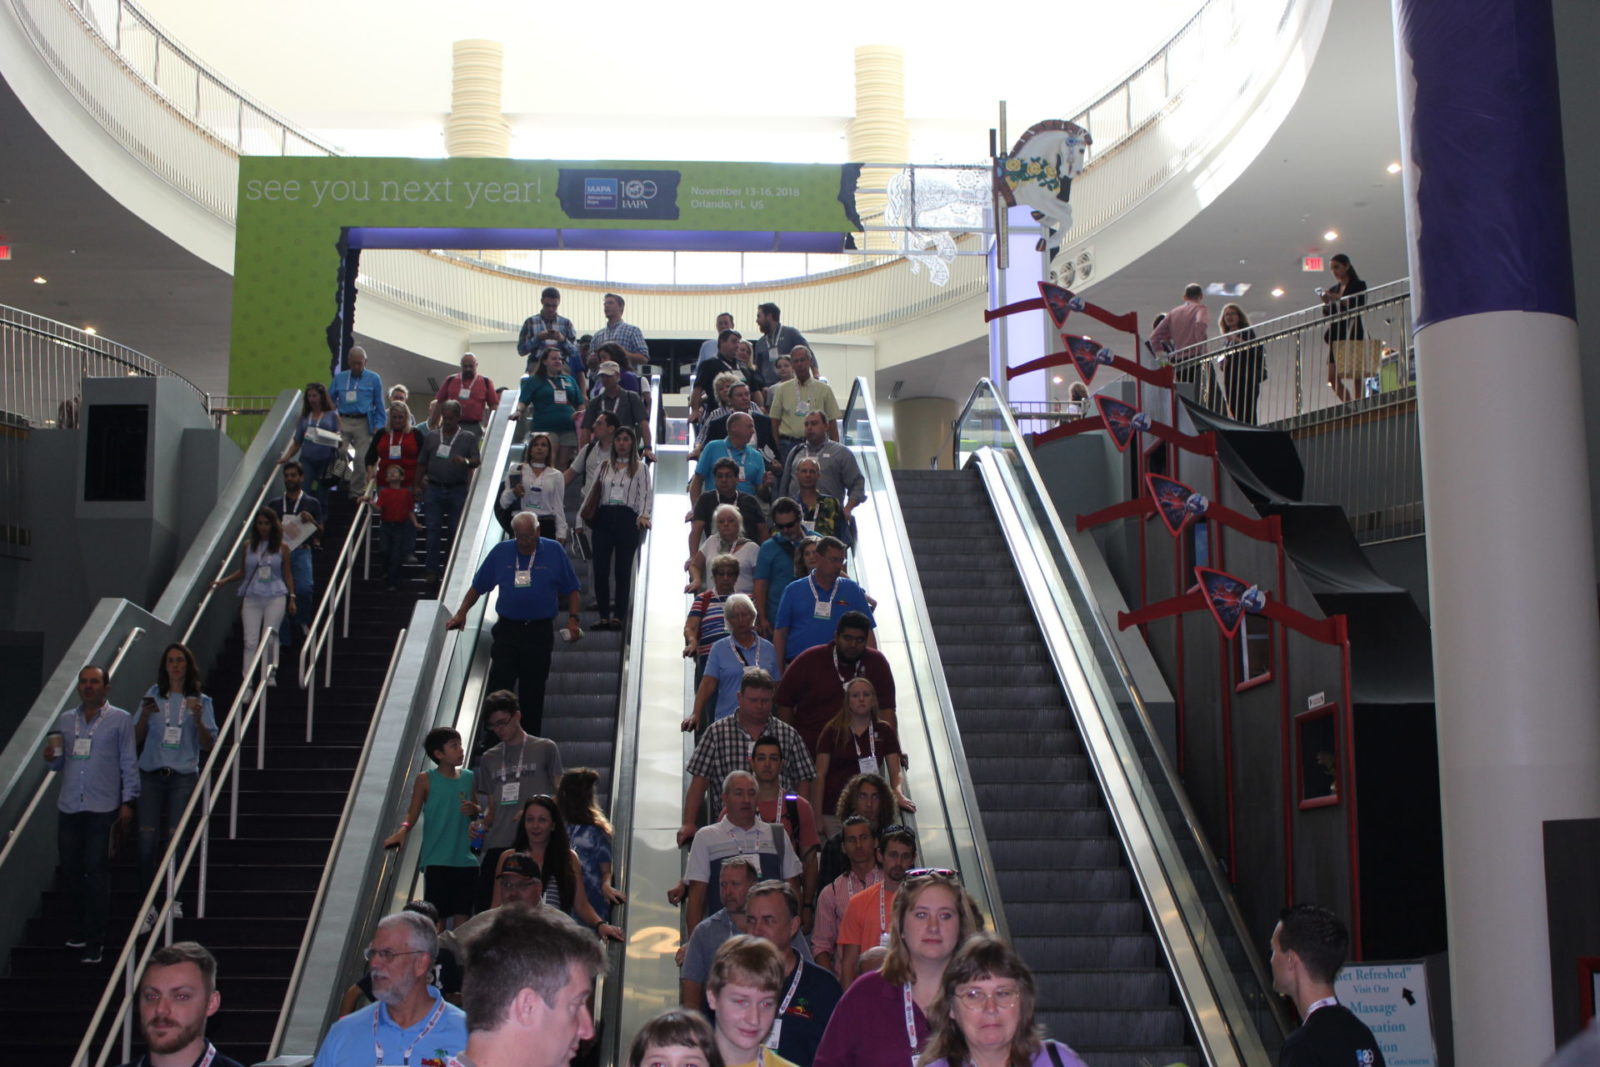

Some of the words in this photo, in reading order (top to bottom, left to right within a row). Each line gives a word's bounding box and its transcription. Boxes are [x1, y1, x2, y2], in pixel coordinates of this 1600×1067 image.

[245, 179, 301, 201] see
[310, 179, 370, 208] you
[379, 177, 453, 203] next
[464, 176, 542, 209] year!
[587, 185, 612, 193] IAAPA
[690, 186, 742, 196] November
[622, 199, 648, 209] IAAPA
[690, 199, 733, 210] Orlando,
[1353, 985, 1372, 993] Visit
[1373, 984, 1390, 993] Our
[1350, 1001, 1398, 1016] Massage
